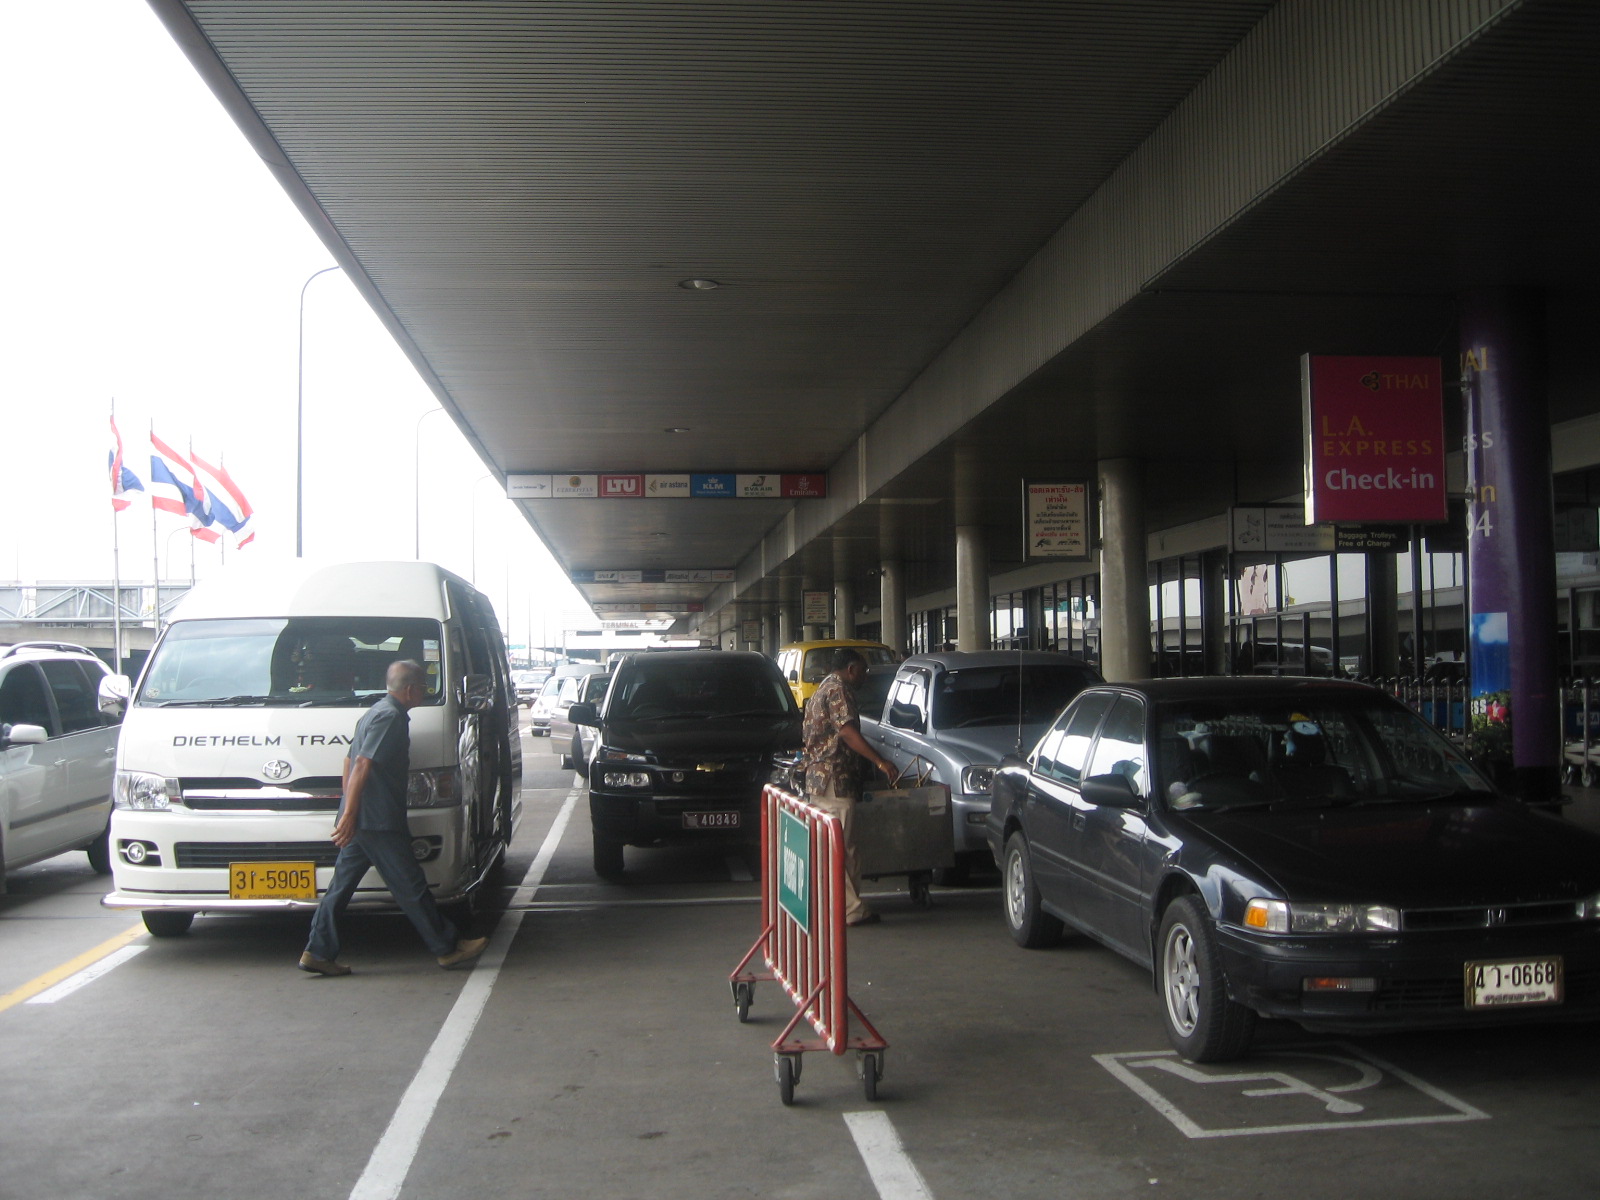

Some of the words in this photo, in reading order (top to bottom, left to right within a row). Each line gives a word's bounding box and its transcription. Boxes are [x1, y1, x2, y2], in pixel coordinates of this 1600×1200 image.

[1383, 374, 1429, 389] THAI
[1322, 415, 1374, 437] L.A.
[1323, 439, 1432, 456] EXPRESS
[1325, 466, 1434, 490] Check-in
[606, 478, 636, 493] LTU
[659, 481, 668, 489] air
[668, 481, 688, 489] astana
[789, 488, 818, 496] Emirates
[1338, 532, 1367, 540] Baggage
[1366, 540, 1391, 548] Charge
[173, 735, 281, 747] DIETHELM
